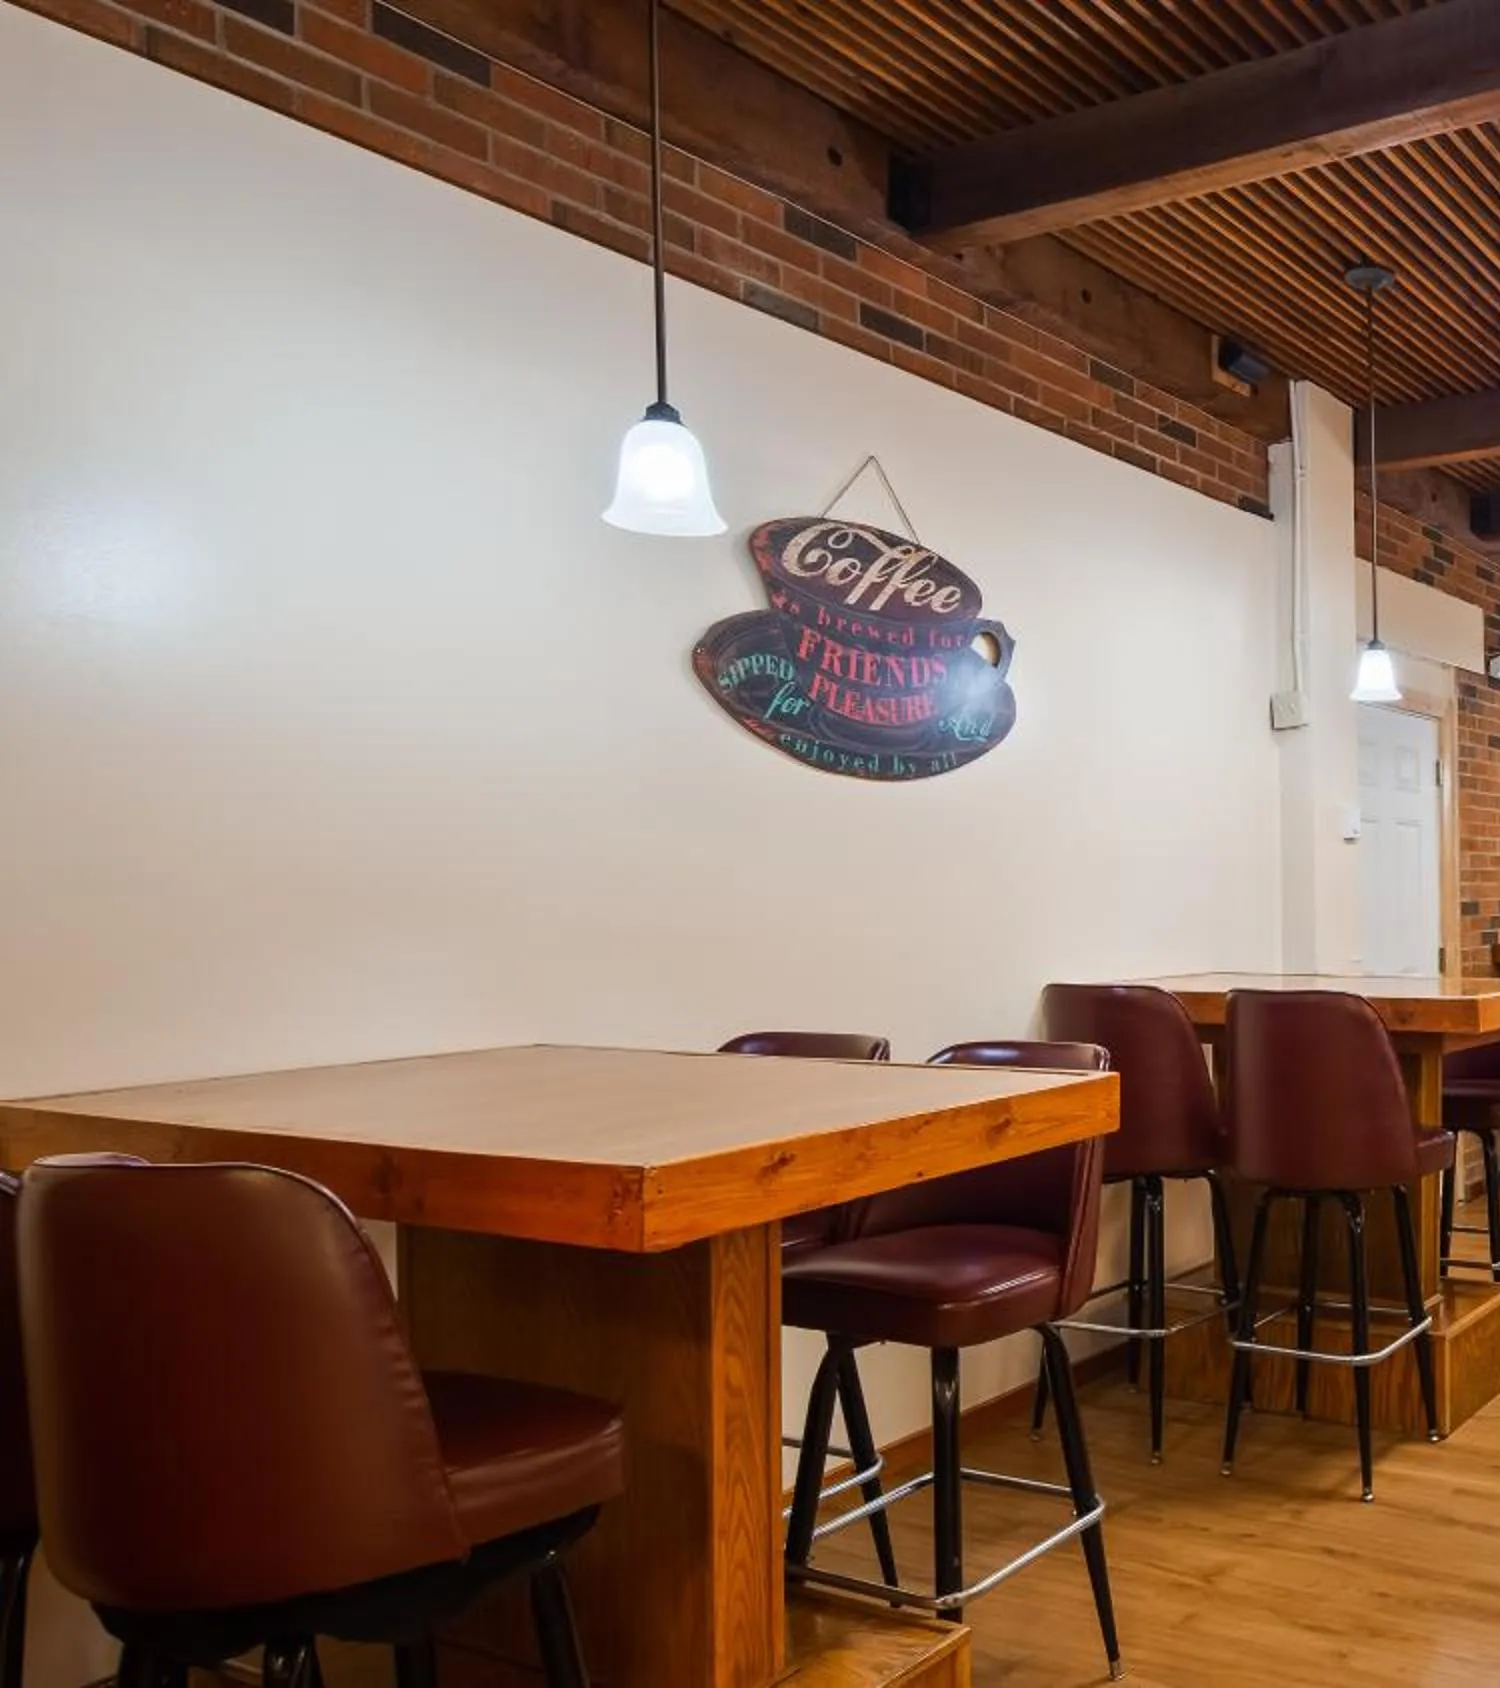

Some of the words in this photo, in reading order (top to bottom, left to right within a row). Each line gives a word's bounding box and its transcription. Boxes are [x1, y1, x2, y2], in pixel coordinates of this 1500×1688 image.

[781, 521, 961, 613] Coffee
[817, 607, 914, 648] brewed
[929, 628, 967, 649] for
[718, 653, 795, 691] SIPPED
[797, 624, 947, 688] FRIENDS
[763, 680, 812, 721] for
[808, 672, 938, 726] PLEASURE
[779, 732, 880, 773] enjoyed
[893, 752, 916, 775] by
[931, 752, 958, 773] all
